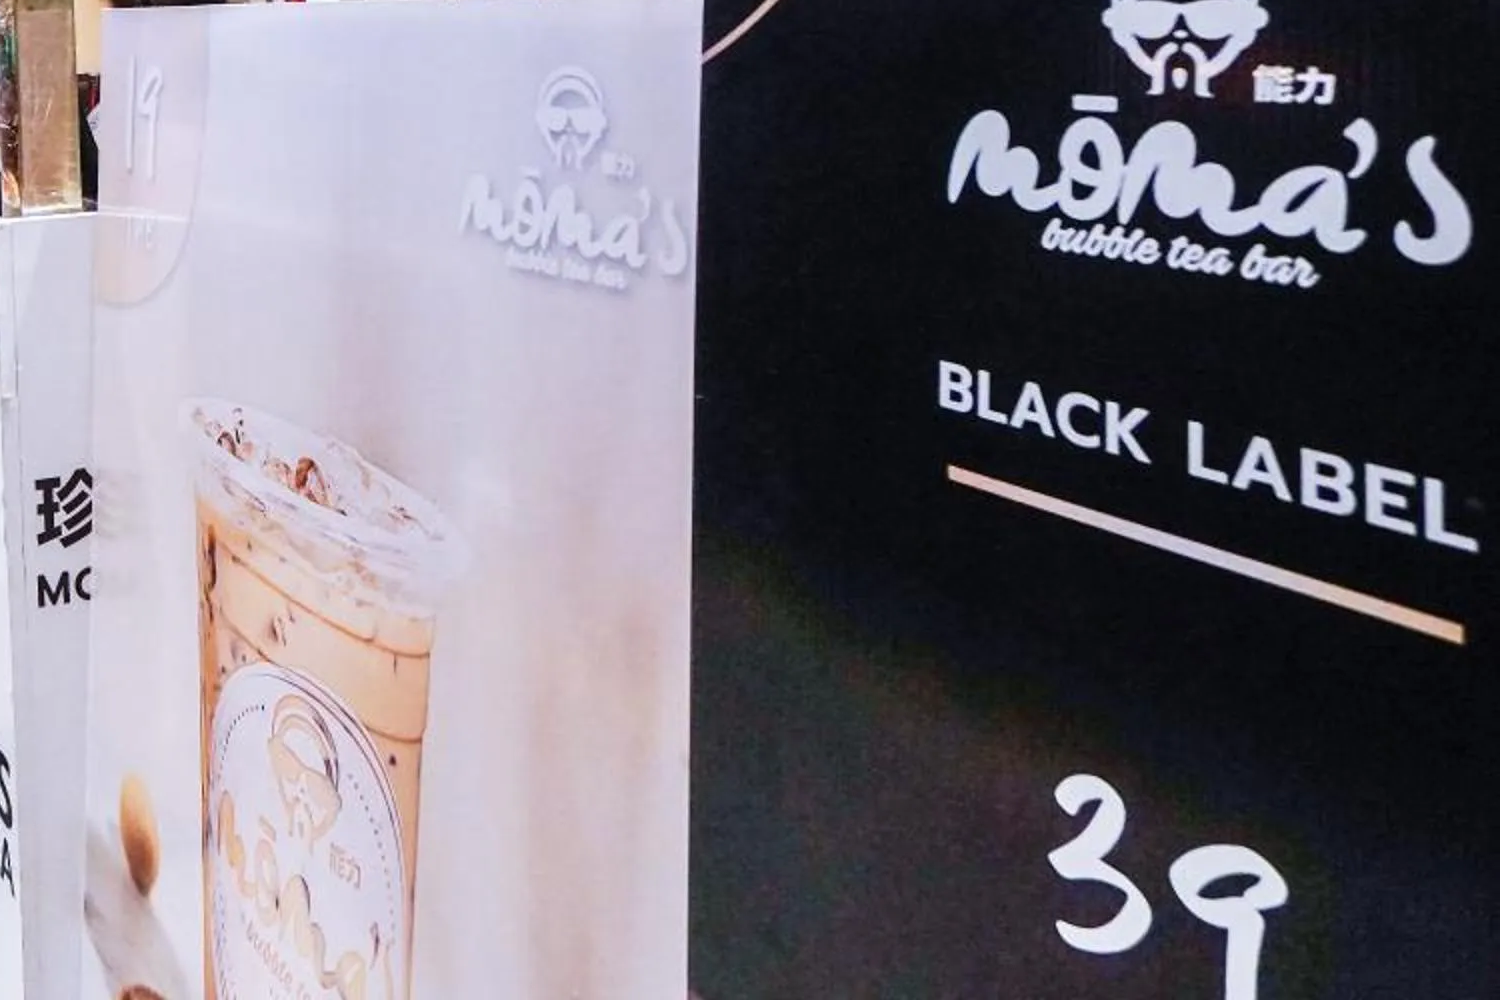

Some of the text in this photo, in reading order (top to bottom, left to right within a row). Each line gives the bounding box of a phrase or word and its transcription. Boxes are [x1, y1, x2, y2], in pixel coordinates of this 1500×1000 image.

[1253, 64, 1336, 107] 能力
[1040, 217, 1322, 289] bubble tea bar
[938, 359, 1480, 553] BLACK LABEL
[1047, 773, 1289, 1000] 39
